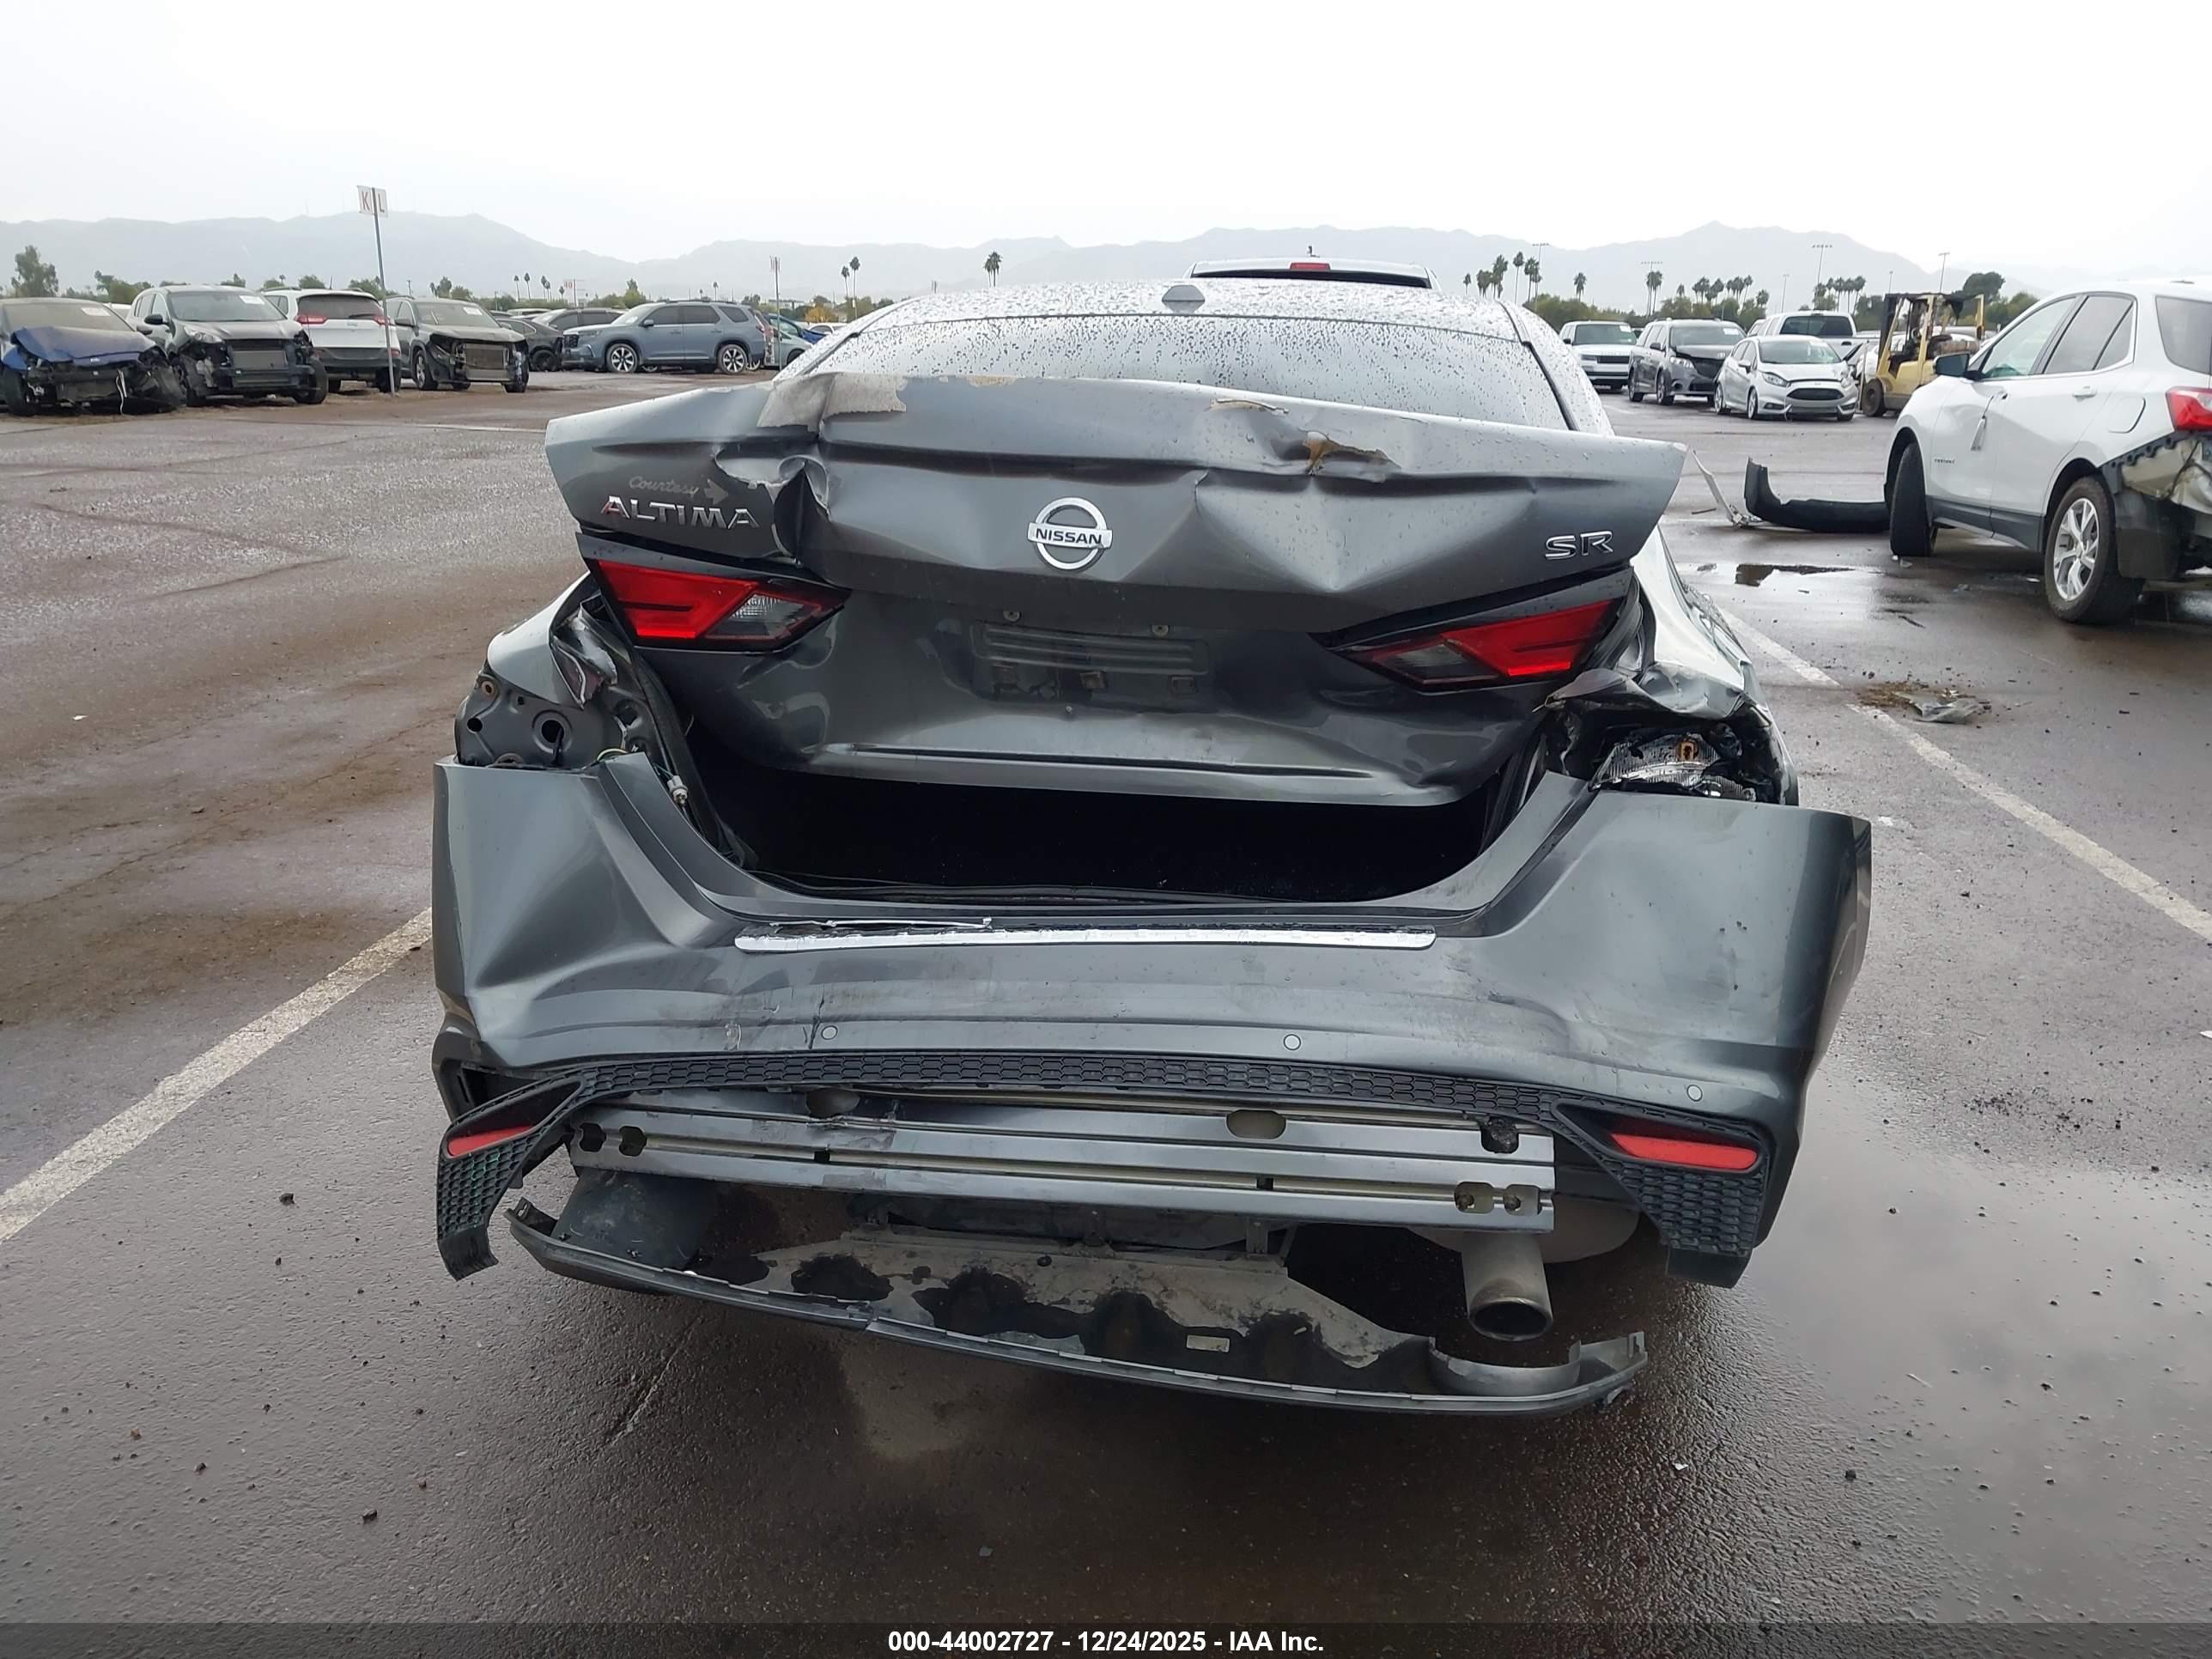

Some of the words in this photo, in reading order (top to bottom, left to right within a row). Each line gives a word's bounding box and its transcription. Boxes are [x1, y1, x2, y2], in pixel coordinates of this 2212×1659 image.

[362, 191, 370, 211] K
[378, 193, 385, 213] L
[629, 476, 699, 498] Courtesy
[601, 495, 760, 529] ALTIMA
[1036, 527, 1102, 544] NISSAN
[1545, 530, 1614, 560] SR
